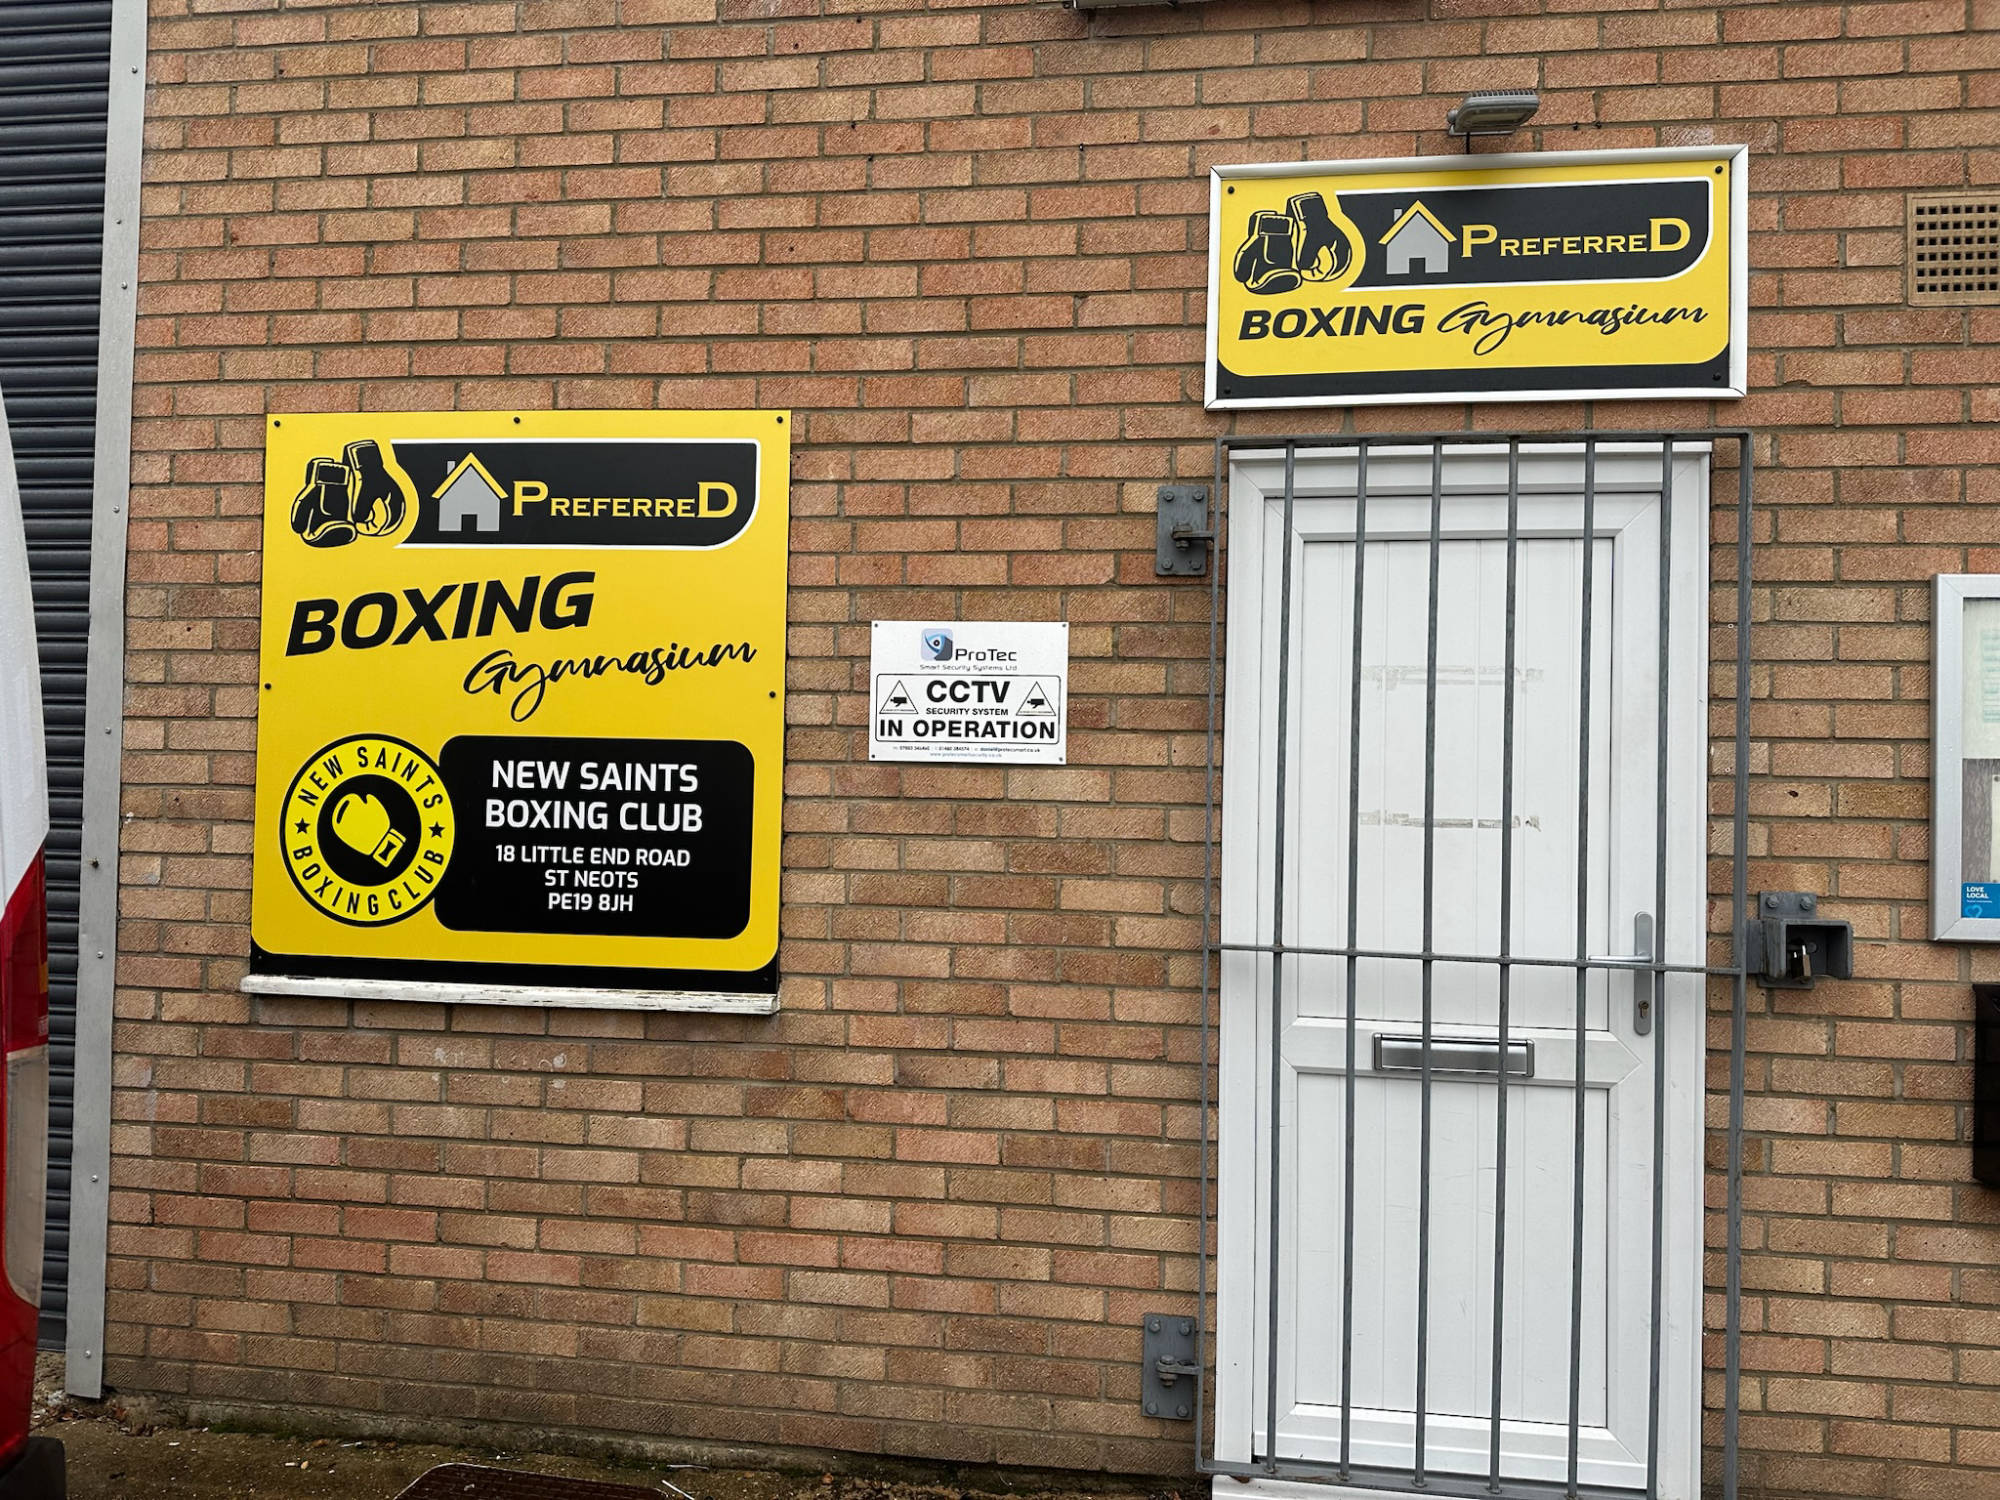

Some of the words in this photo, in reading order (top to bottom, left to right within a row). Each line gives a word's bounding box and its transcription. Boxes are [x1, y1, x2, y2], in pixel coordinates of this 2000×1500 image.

[1239, 304, 1425, 340] BOXING
[1437, 301, 1708, 356] Gymnasium
[286, 572, 595, 657] BOXING
[956, 649, 1016, 661] ProTec
[464, 637, 757, 722] Gymnasium
[943, 664, 970, 672] Security
[973, 664, 1003, 672] Systems
[927, 680, 1010, 703] CCTV
[880, 720, 902, 736] IN
[913, 720, 1054, 738] OPERATION
[298, 755, 344, 806] NEW
[357, 746, 443, 809] SAINTS
[493, 760, 570, 789] NEW
[580, 762, 697, 792] SAINTS
[486, 799, 607, 829] BOXING
[620, 802, 702, 832] CLUB
[496, 845, 515, 862] 18
[522, 846, 584, 863] LITTLE
[591, 848, 629, 865] END
[636, 849, 690, 866] ROAD
[545, 869, 569, 886] ST
[575, 870, 638, 888] NEOTS
[549, 893, 592, 910] PE19
[599, 894, 633, 911] 8JH
